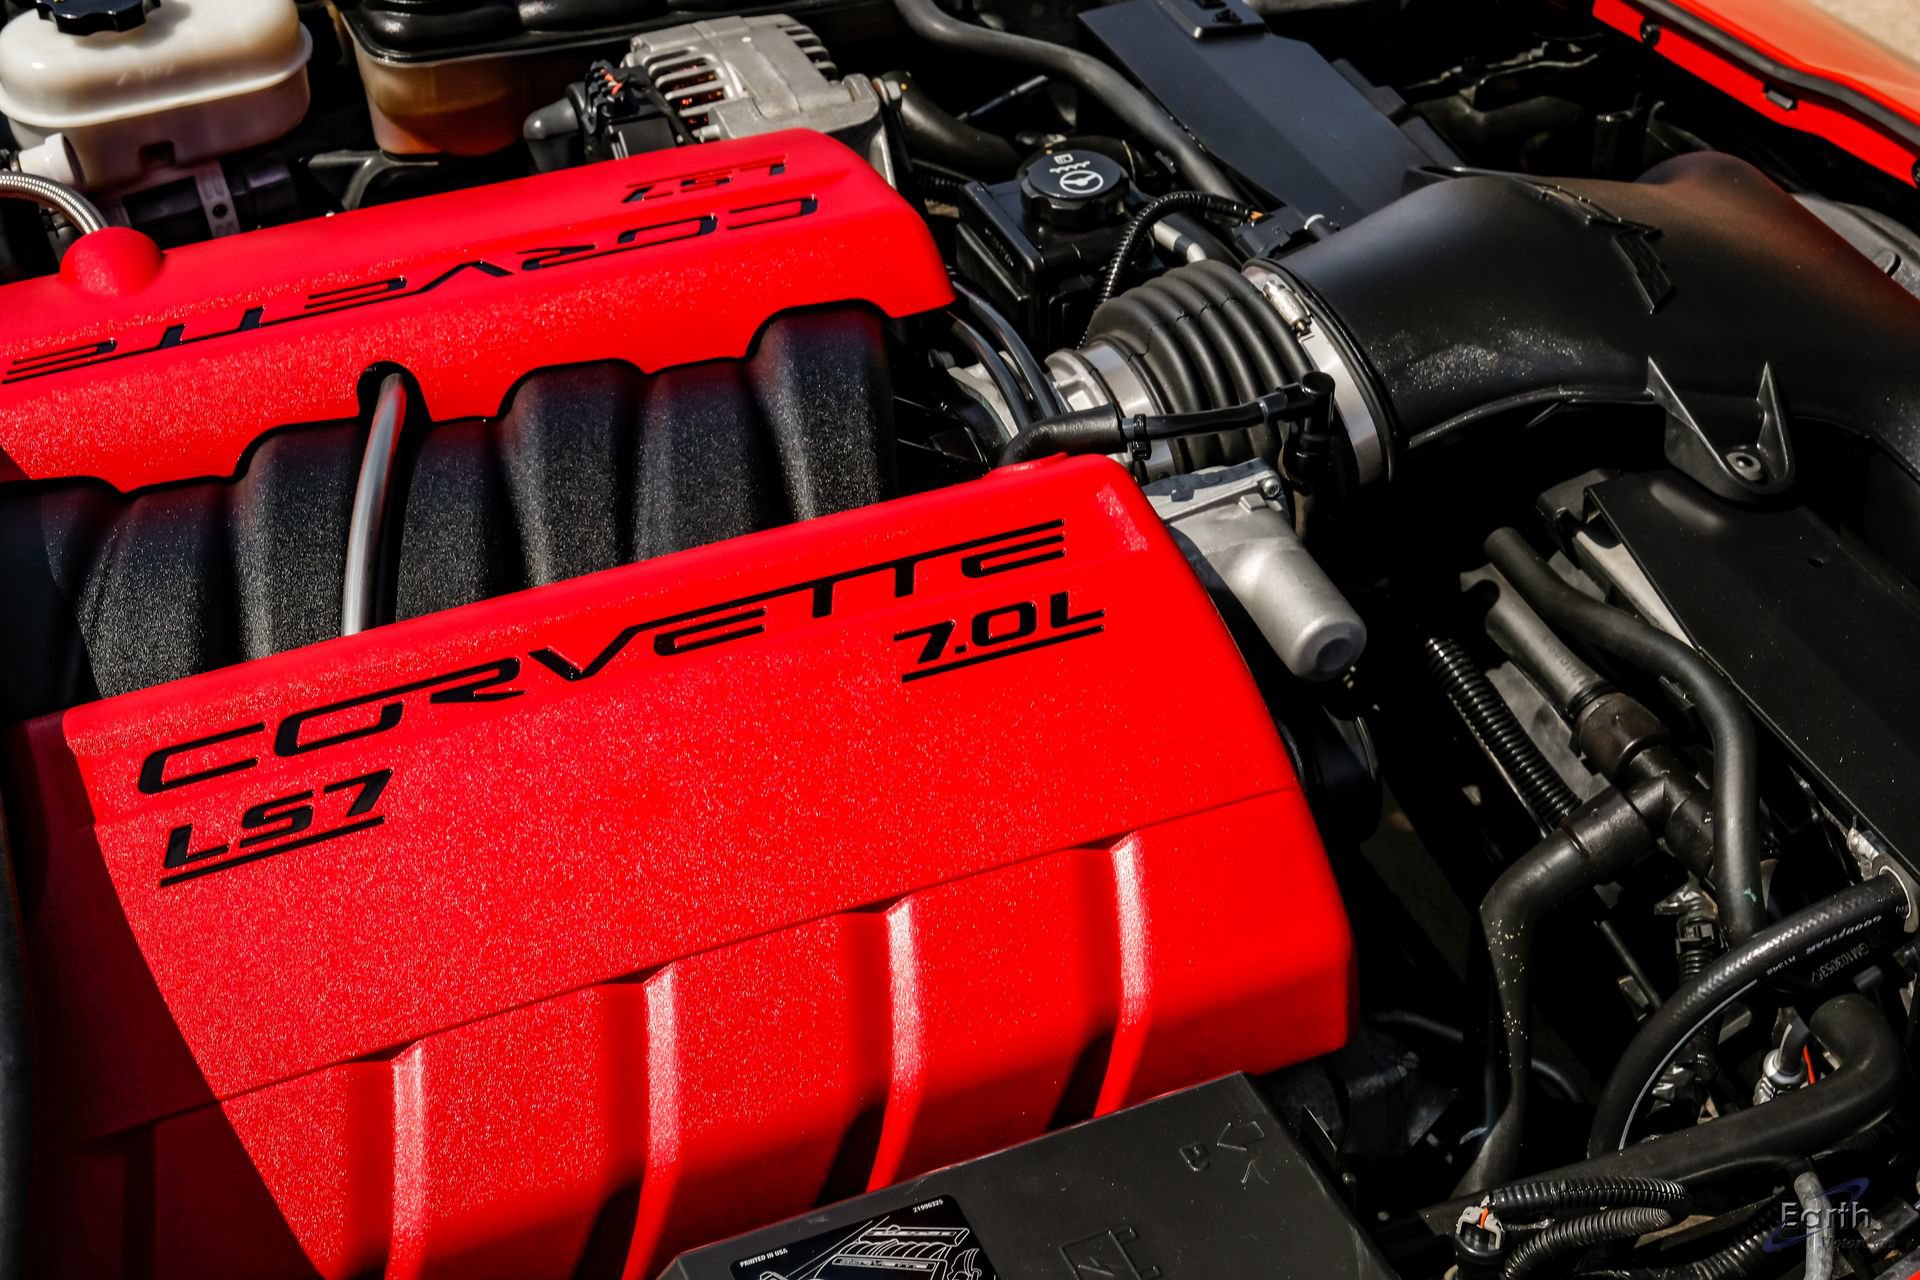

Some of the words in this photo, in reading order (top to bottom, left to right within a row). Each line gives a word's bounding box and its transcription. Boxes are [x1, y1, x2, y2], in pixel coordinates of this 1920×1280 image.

[1, 198, 819, 384] CORVETTE
[138, 518, 1066, 794] CORVETTE
[893, 591, 1105, 664] 7.0L
[163, 769, 394, 869] LS7
[1806, 915, 1883, 955] GOODYEAR
[739, 1253, 766, 1268] PRINTED
[774, 1247, 788, 1257] USA
